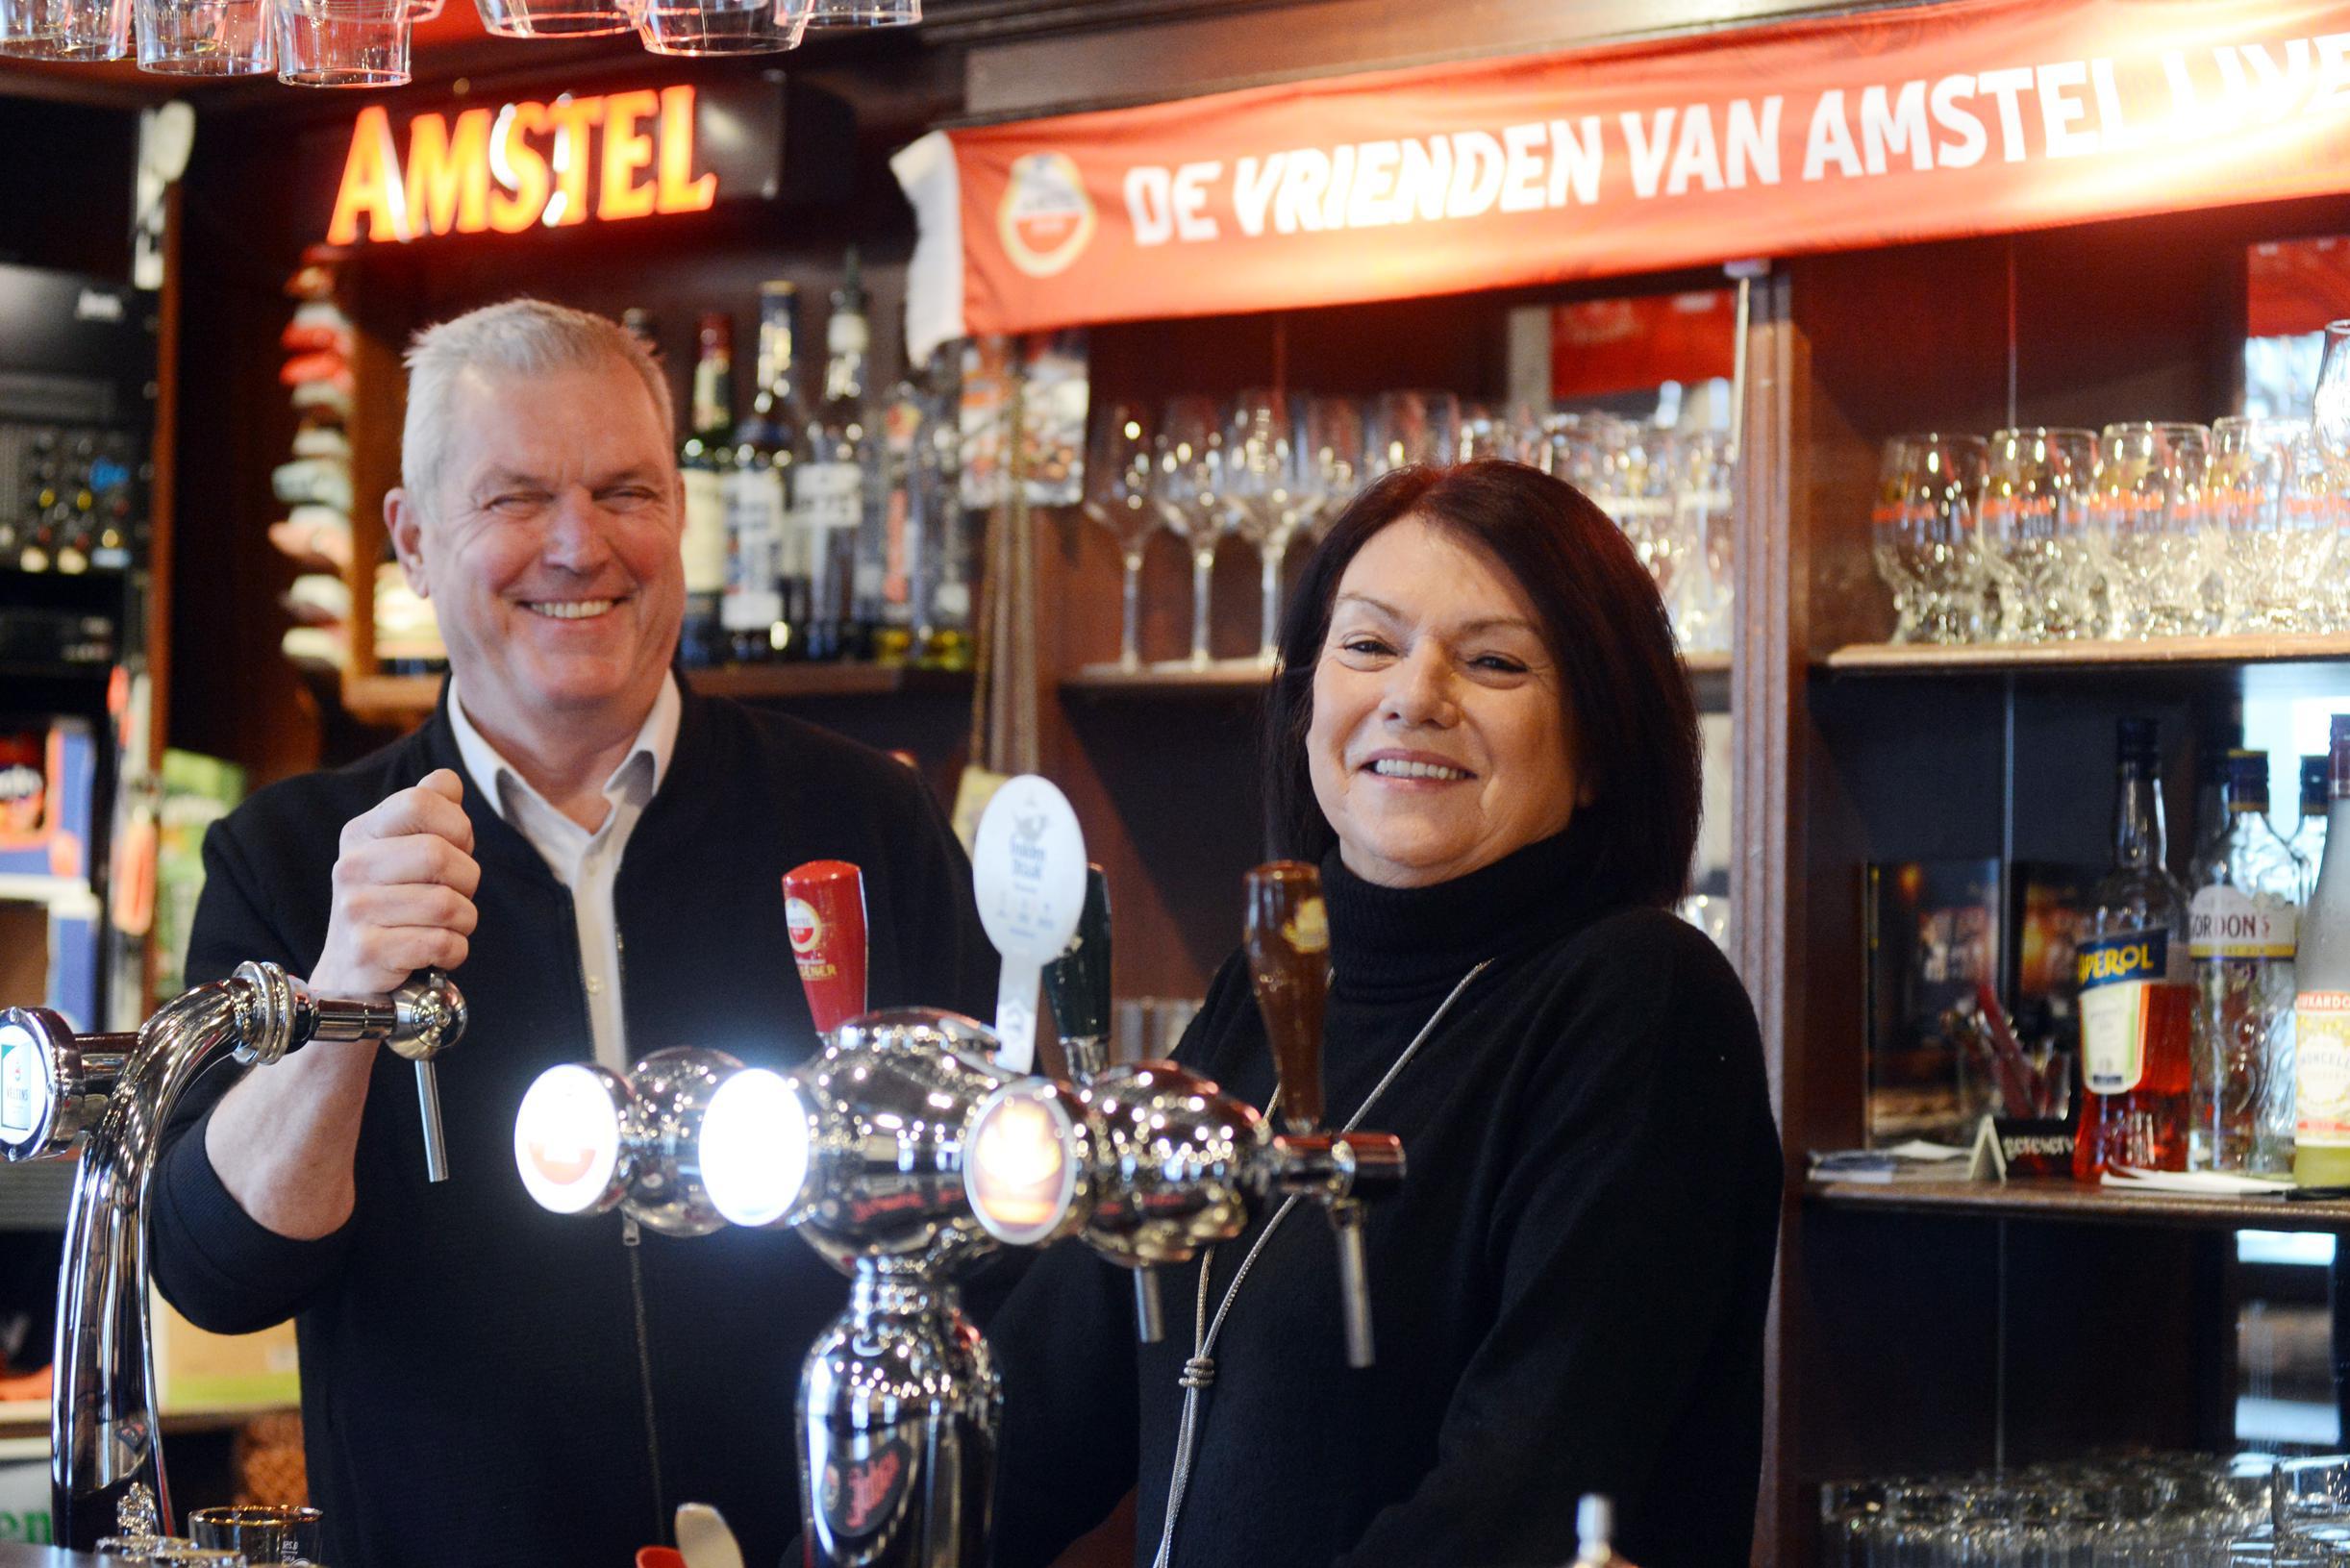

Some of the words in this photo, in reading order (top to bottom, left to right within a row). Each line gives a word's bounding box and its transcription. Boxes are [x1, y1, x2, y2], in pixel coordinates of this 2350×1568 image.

[327, 85, 718, 246] AMSTEL
[1123, 161, 1223, 246] DE
[1233, 115, 1603, 236] VRIENDEN
[1620, 95, 1784, 199] VAN
[1802, 56, 2142, 182] AMSTEL
[2078, 942, 2154, 984] APEROL
